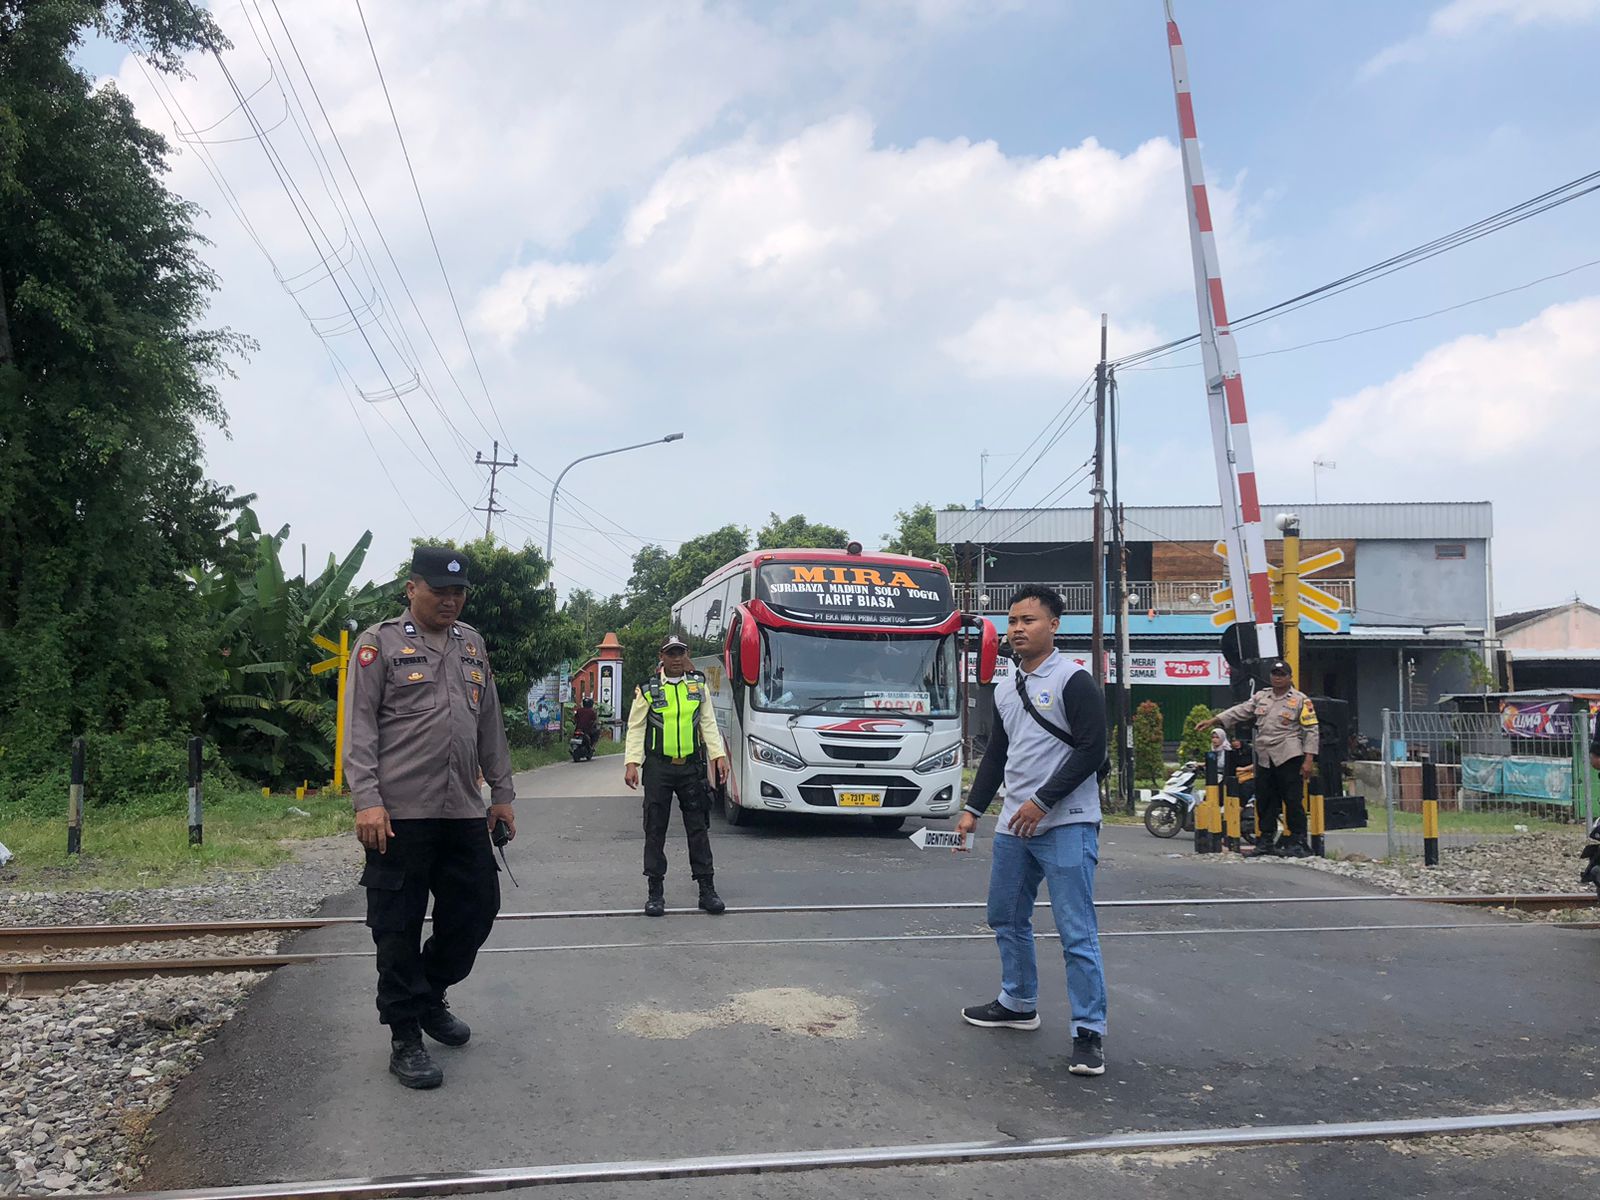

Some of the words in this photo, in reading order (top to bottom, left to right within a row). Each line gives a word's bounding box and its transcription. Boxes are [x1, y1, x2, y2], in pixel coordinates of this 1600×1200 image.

[789, 566, 920, 588] MIRA
[770, 583, 824, 593] SURABAYA
[829, 584, 869, 594] MADIUN
[875, 586, 900, 597] SOLO
[907, 588, 940, 601] YOGYA
[817, 593, 853, 606] TARIF
[858, 594, 895, 609] BIASA
[815, 612, 824, 620] PT
[1131, 658, 1156, 667] MERAH
[1130, 669, 1157, 678] SAMAA!
[926, 832, 962, 846] IDENTIFIKAS
